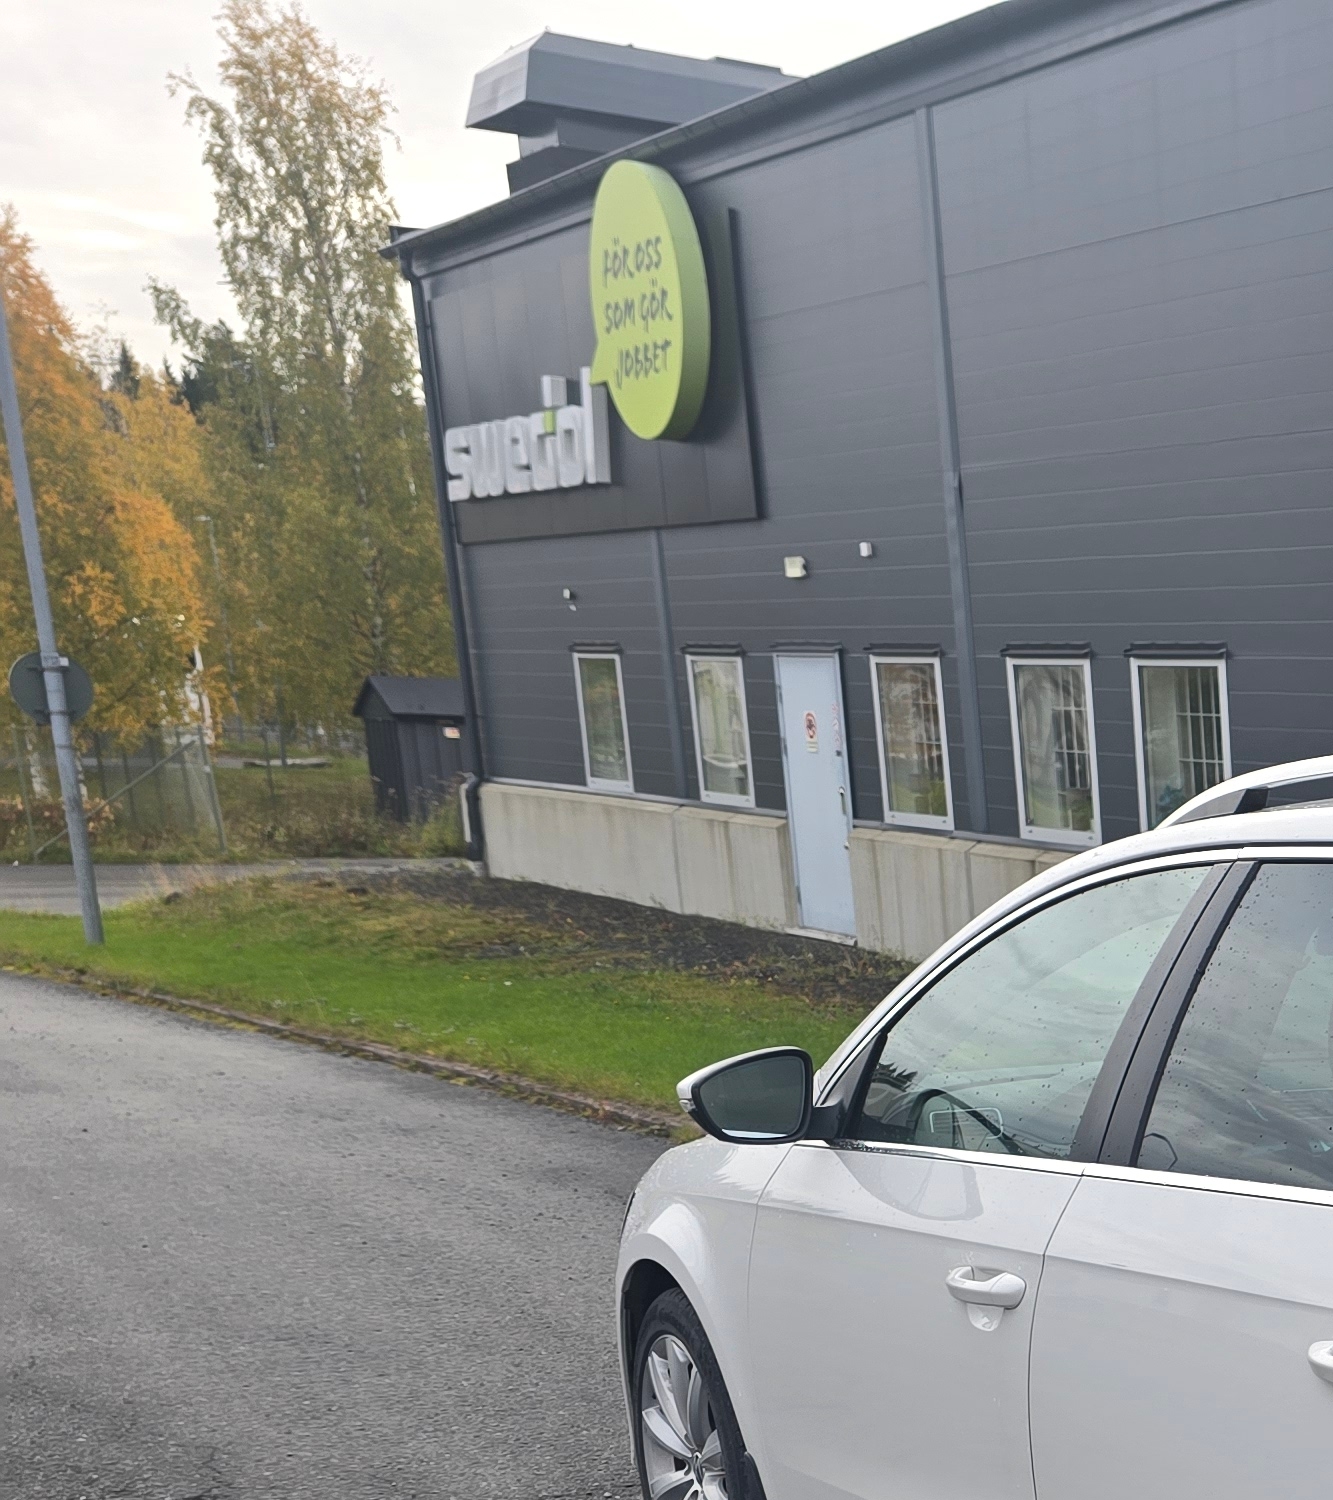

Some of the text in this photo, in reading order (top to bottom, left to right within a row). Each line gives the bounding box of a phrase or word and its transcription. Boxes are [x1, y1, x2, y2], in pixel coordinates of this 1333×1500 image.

[635, 235, 662, 273] OSS
[605, 297, 635, 335] SOM
[615, 338, 673, 390] JOBBET
